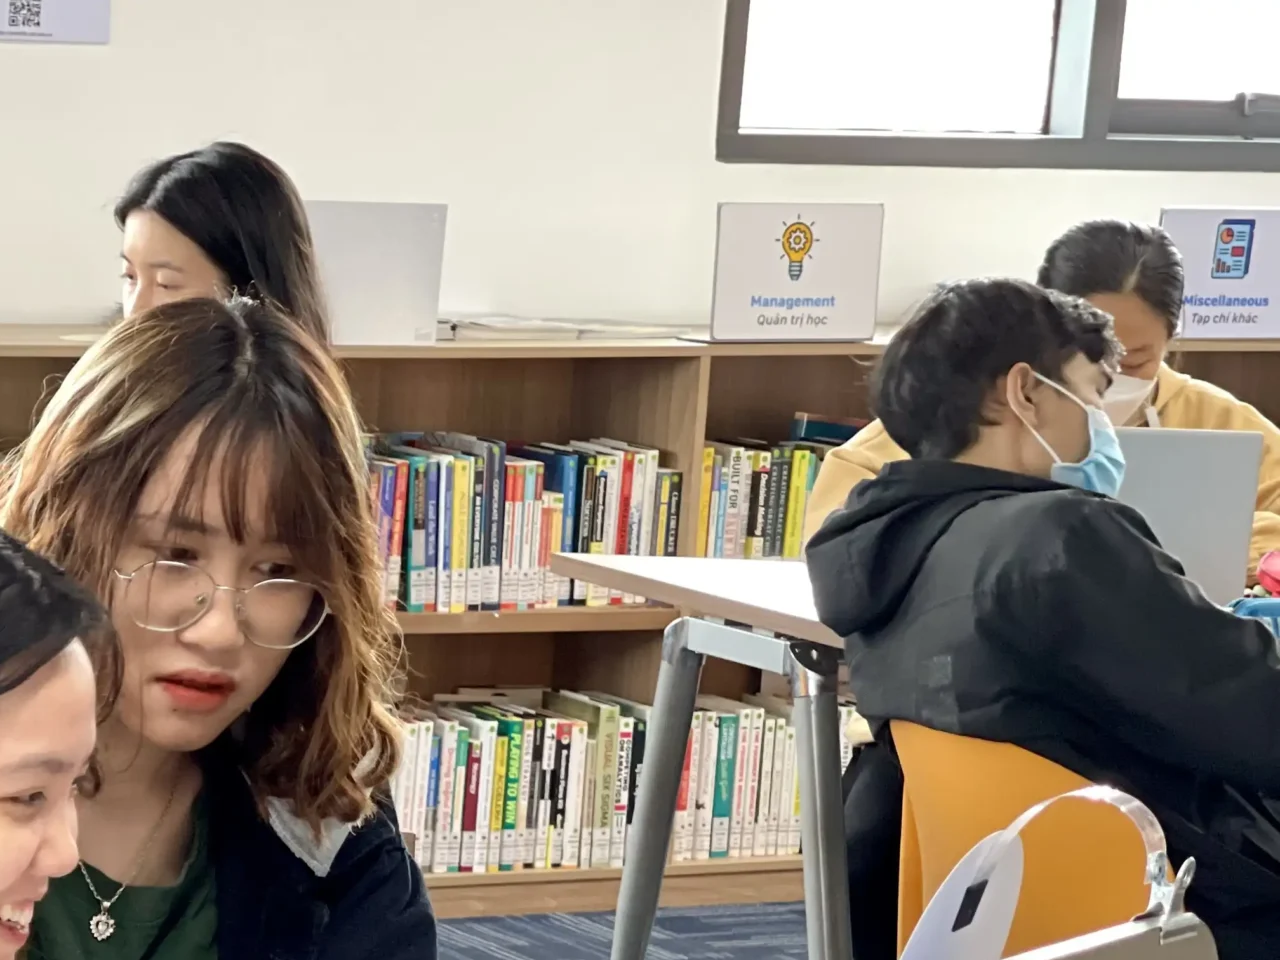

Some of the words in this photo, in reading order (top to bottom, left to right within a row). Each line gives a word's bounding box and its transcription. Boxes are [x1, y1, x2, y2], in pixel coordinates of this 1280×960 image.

[750, 295, 835, 310] Management
[1182, 294, 1269, 306] Miscellaneous
[757, 313, 787, 326] Quản
[791, 314, 804, 328] trị
[806, 315, 828, 326] học
[1192, 313, 1210, 326] Tạp
[1212, 312, 1229, 323] chí
[1232, 312, 1258, 324] khác
[731, 456, 742, 484] BUILT
[491, 479, 500, 521] CORPORATE
[729, 489, 738, 509] FOR
[759, 473, 768, 505] Decision
[582, 499, 592, 538] Success
[490, 545, 498, 566] CREA
[508, 733, 521, 778] PLAYING
[603, 732, 614, 769] VISUAL
[619, 739, 625, 752] ON
[623, 739, 632, 792] COMPETING
[507, 782, 518, 797] TO
[603, 774, 611, 790] SIX
[615, 754, 624, 804] ANALYTICS
[505, 800, 516, 824] WIN
[600, 794, 610, 828] SIGMA
